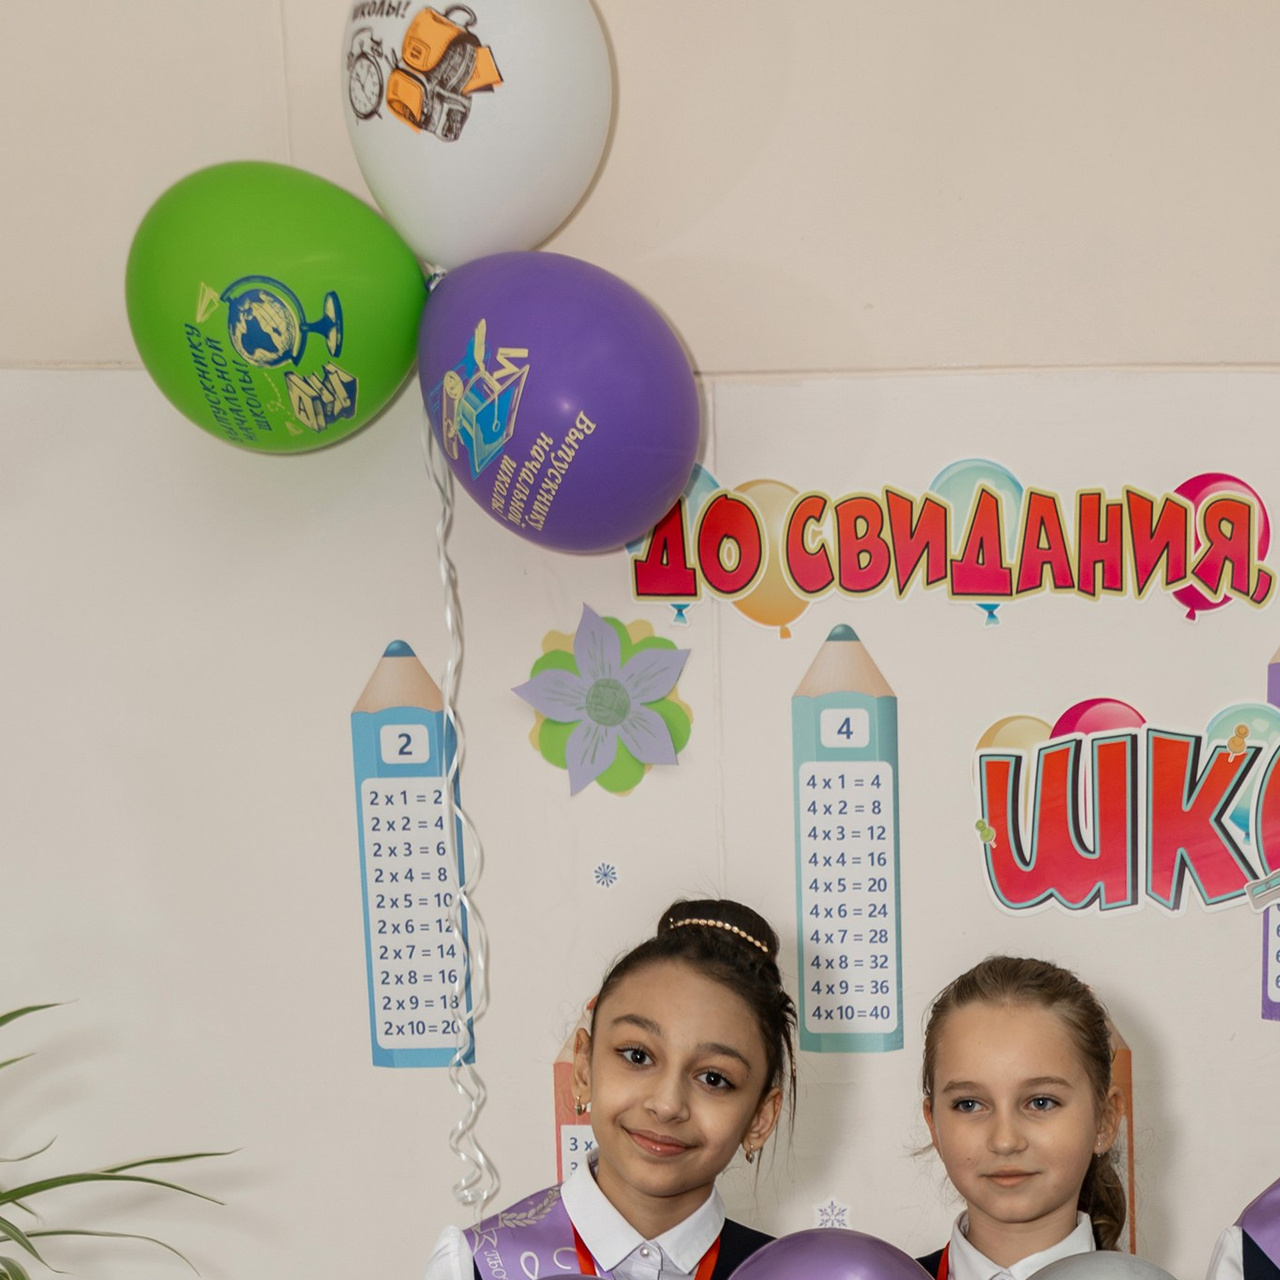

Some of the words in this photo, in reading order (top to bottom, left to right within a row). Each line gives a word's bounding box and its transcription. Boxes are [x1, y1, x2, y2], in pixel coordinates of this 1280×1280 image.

[525, 410, 596, 532] Выпускнику
[507, 432, 554, 529] начальной
[632, 492, 764, 599] ДО
[785, 484, 1276, 605] СВИДАНИЯ,
[837, 717, 853, 739] 4
[398, 733, 413, 756] 2
[805, 773, 818, 790] 4
[837, 773, 846, 790] 1
[869, 773, 882, 790] 4
[369, 790, 380, 807] 2
[399, 789, 408, 806] 1
[433, 788, 443, 805] 2
[806, 799, 819, 816] 4
[837, 799, 848, 816] 2
[871, 799, 883, 816] 8
[371, 816, 381, 833] 2
[401, 815, 412, 832] 2
[433, 815, 445, 831] 4
[807, 825, 819, 841] 4
[835, 825, 846, 841] 3
[866, 825, 887, 841] 12
[372, 841, 383, 858] 2
[403, 841, 413, 857] 3
[435, 840, 447, 857] 6
[807, 851, 820, 868] 4
[835, 851, 847, 867] 4
[867, 851, 887, 867] 16
[374, 867, 385, 884] 2
[403, 867, 415, 883] 4
[437, 866, 448, 883] 8
[808, 877, 821, 893] 4
[837, 877, 847, 893] 5
[867, 877, 888, 893] 20
[379, 944, 389, 961] 2
[405, 944, 417, 960] 7
[436, 943, 457, 960] 14
[569, 1137, 578, 1152] 3
